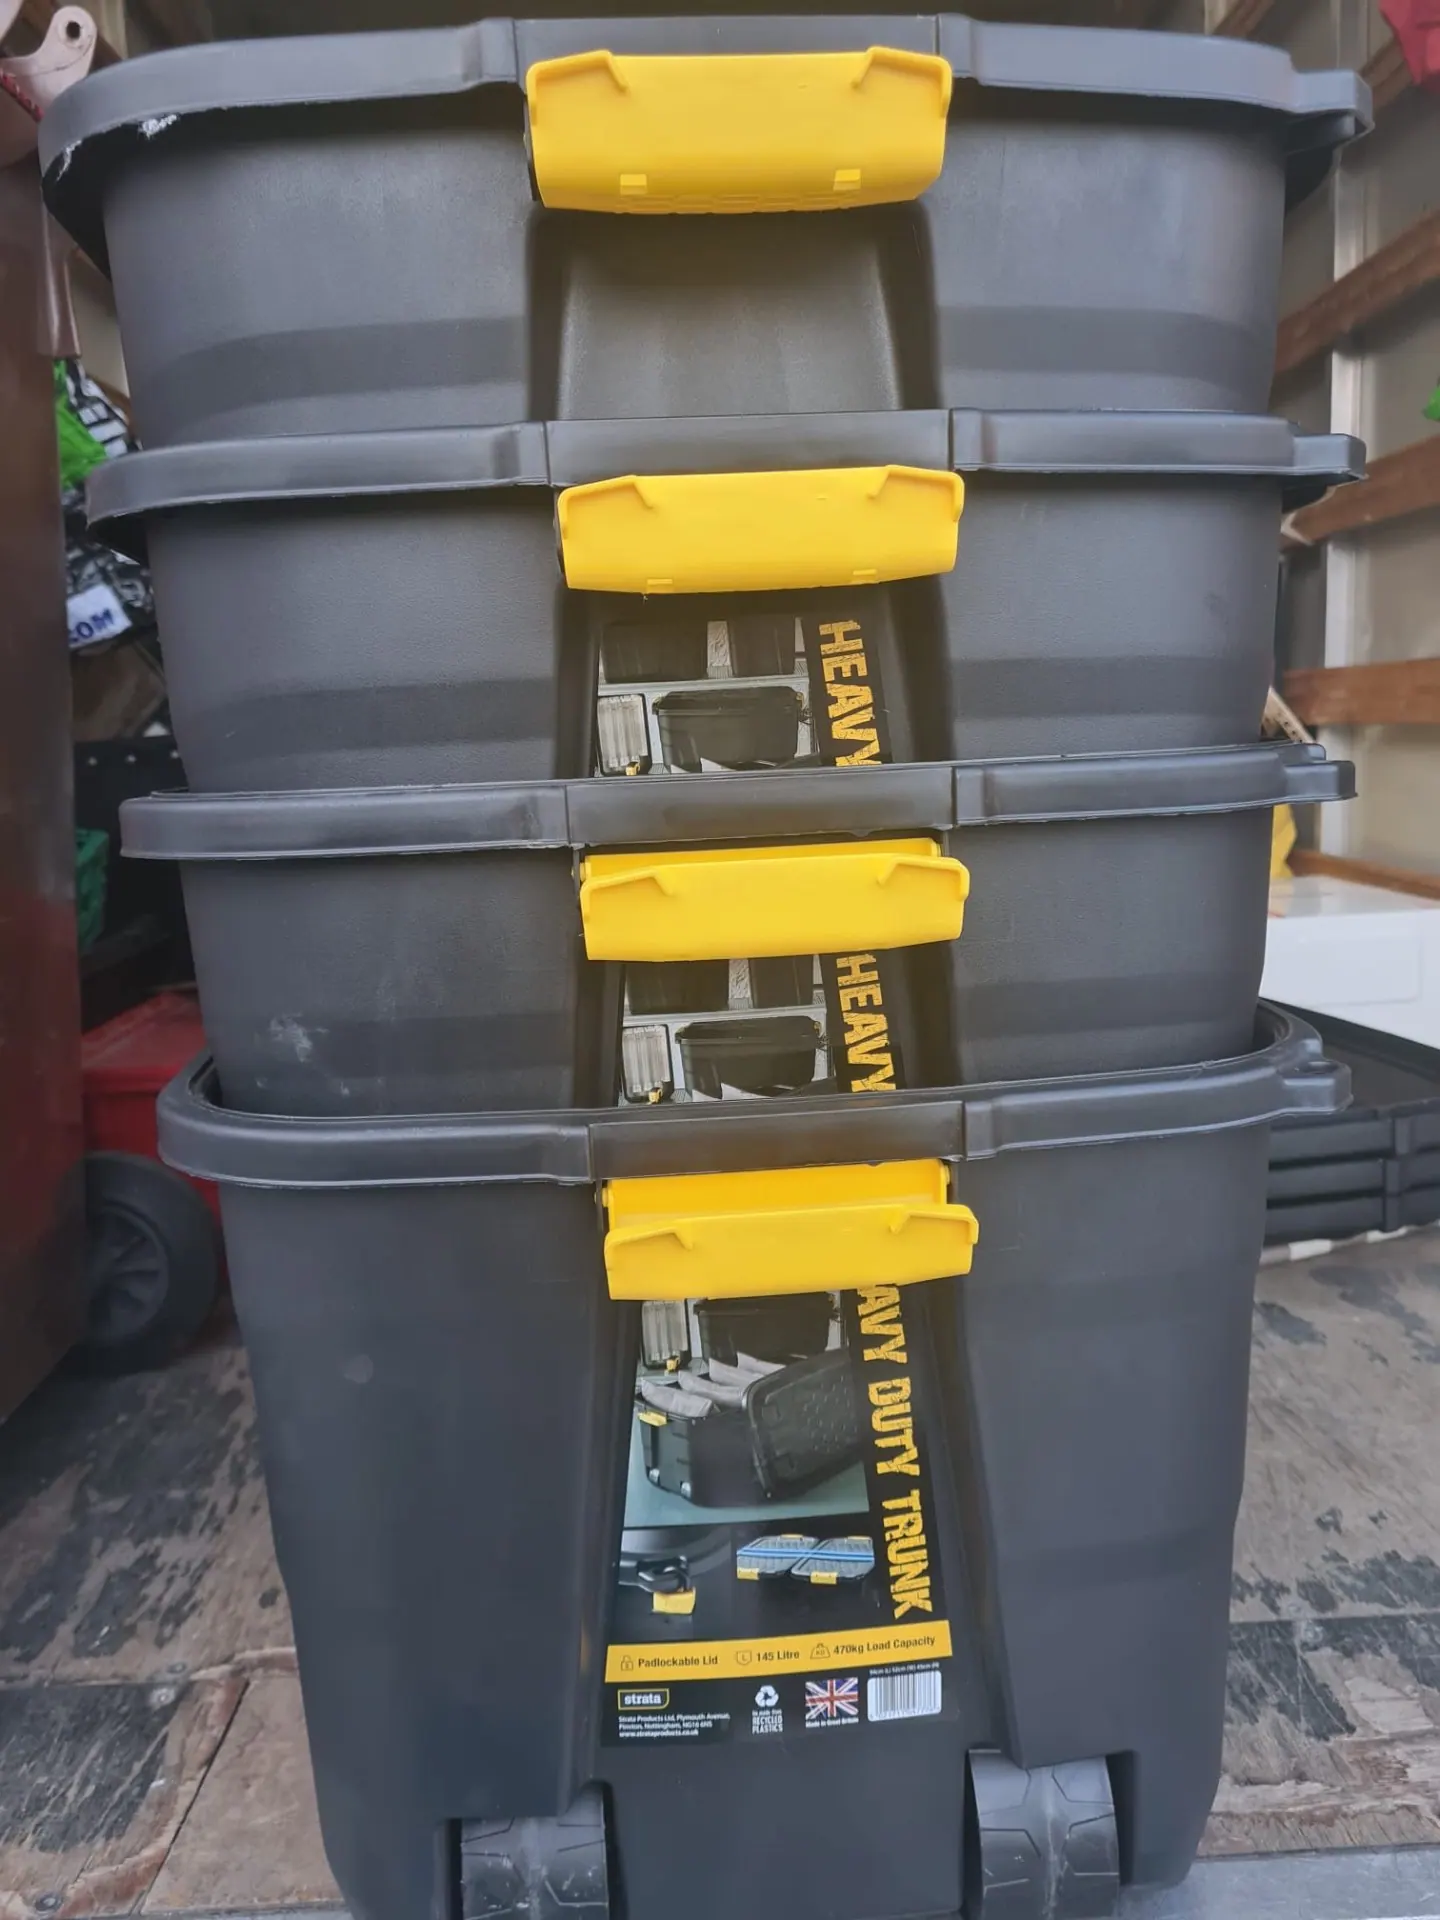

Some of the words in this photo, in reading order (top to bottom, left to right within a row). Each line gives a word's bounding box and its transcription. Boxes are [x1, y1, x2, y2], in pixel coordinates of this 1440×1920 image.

[819, 620, 882, 767] HEAVY
[836, 954, 897, 1092] HEAVY
[857, 1284, 907, 1364] AVY
[868, 1376, 920, 1476] DUTY
[882, 1489, 933, 1619] TRUNK
[833, 1643, 864, 1655] 470kg
[867, 1640, 890, 1651] Load
[893, 1635, 935, 1649] Capacity
[638, 1655, 700, 1669] Padlockable
[703, 1654, 718, 1665] Lid
[757, 1651, 774, 1662] 145
[777, 1648, 799, 1660] Litre
[624, 1692, 661, 1705] strata
[636, 1714, 664, 1722] Products
[676, 1712, 705, 1722] Plymouth
[752, 1714, 783, 1725] RECYCLED
[805, 1720, 820, 1728] Made
[827, 1718, 841, 1726] Great
[841, 1716, 859, 1725] Britain
[752, 1723, 783, 1735] PLASTICS
